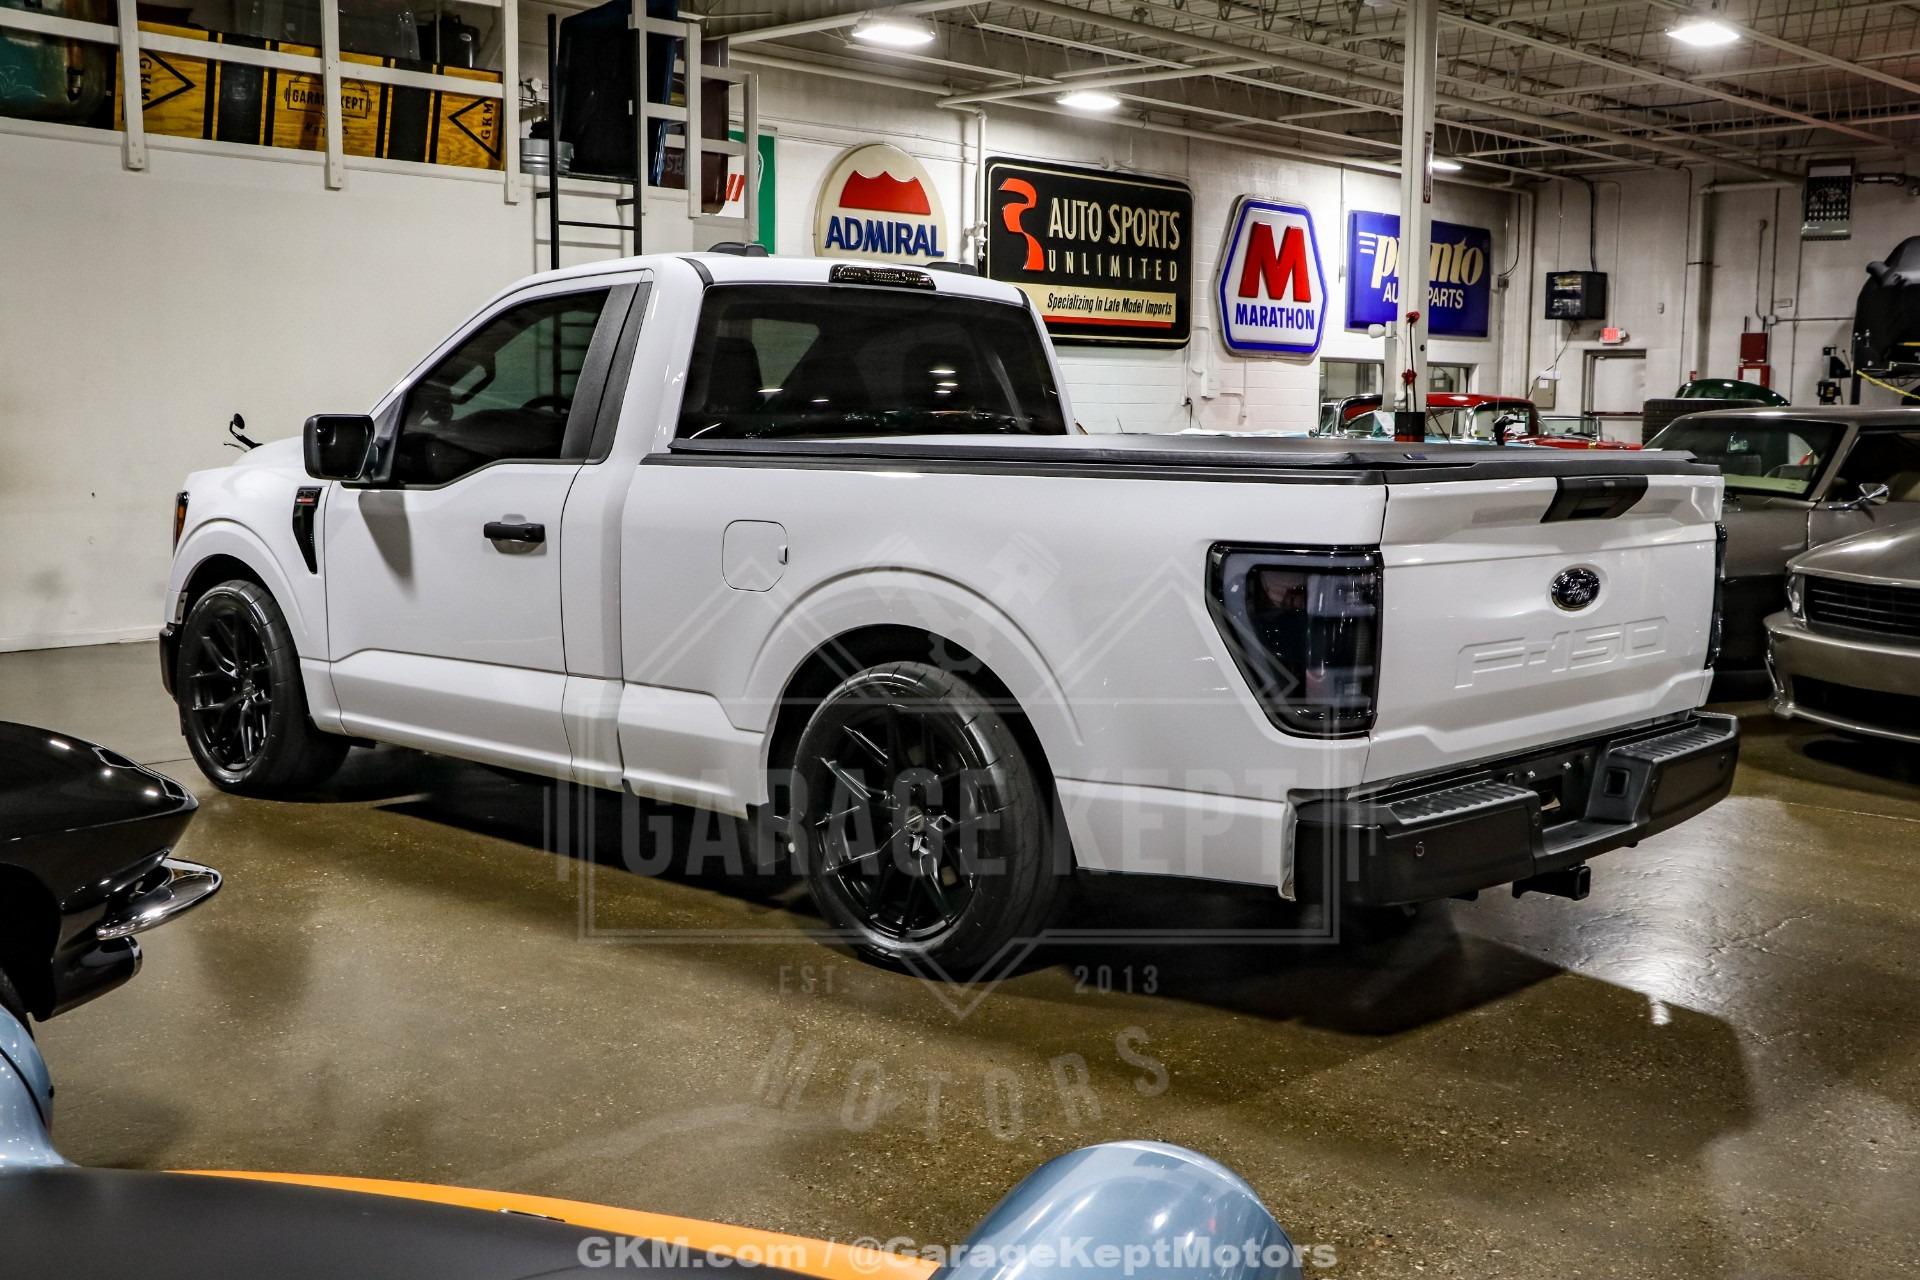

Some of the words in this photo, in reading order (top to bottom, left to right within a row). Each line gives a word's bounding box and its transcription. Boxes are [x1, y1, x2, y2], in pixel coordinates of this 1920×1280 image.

[140, 57, 152, 101] GKM
[292, 89, 326, 106] GARA
[480, 103, 495, 140] GKM
[825, 215, 945, 258] ADMIRAL
[1048, 197, 1103, 243] AUTO
[1107, 203, 1181, 251] SPORTS
[1047, 249, 1178, 283] UNLIMITED
[1238, 221, 1312, 304] M
[1371, 234, 1484, 289] pnto
[1047, 292, 1094, 313] Specializing
[1103, 296, 1121, 312] Late
[1121, 297, 1145, 314] Model
[1145, 299, 1173, 317] Imports
[1235, 302, 1315, 331] MARATHON
[1427, 287, 1464, 310] PARTS
[1454, 615, 1669, 689] F-150
